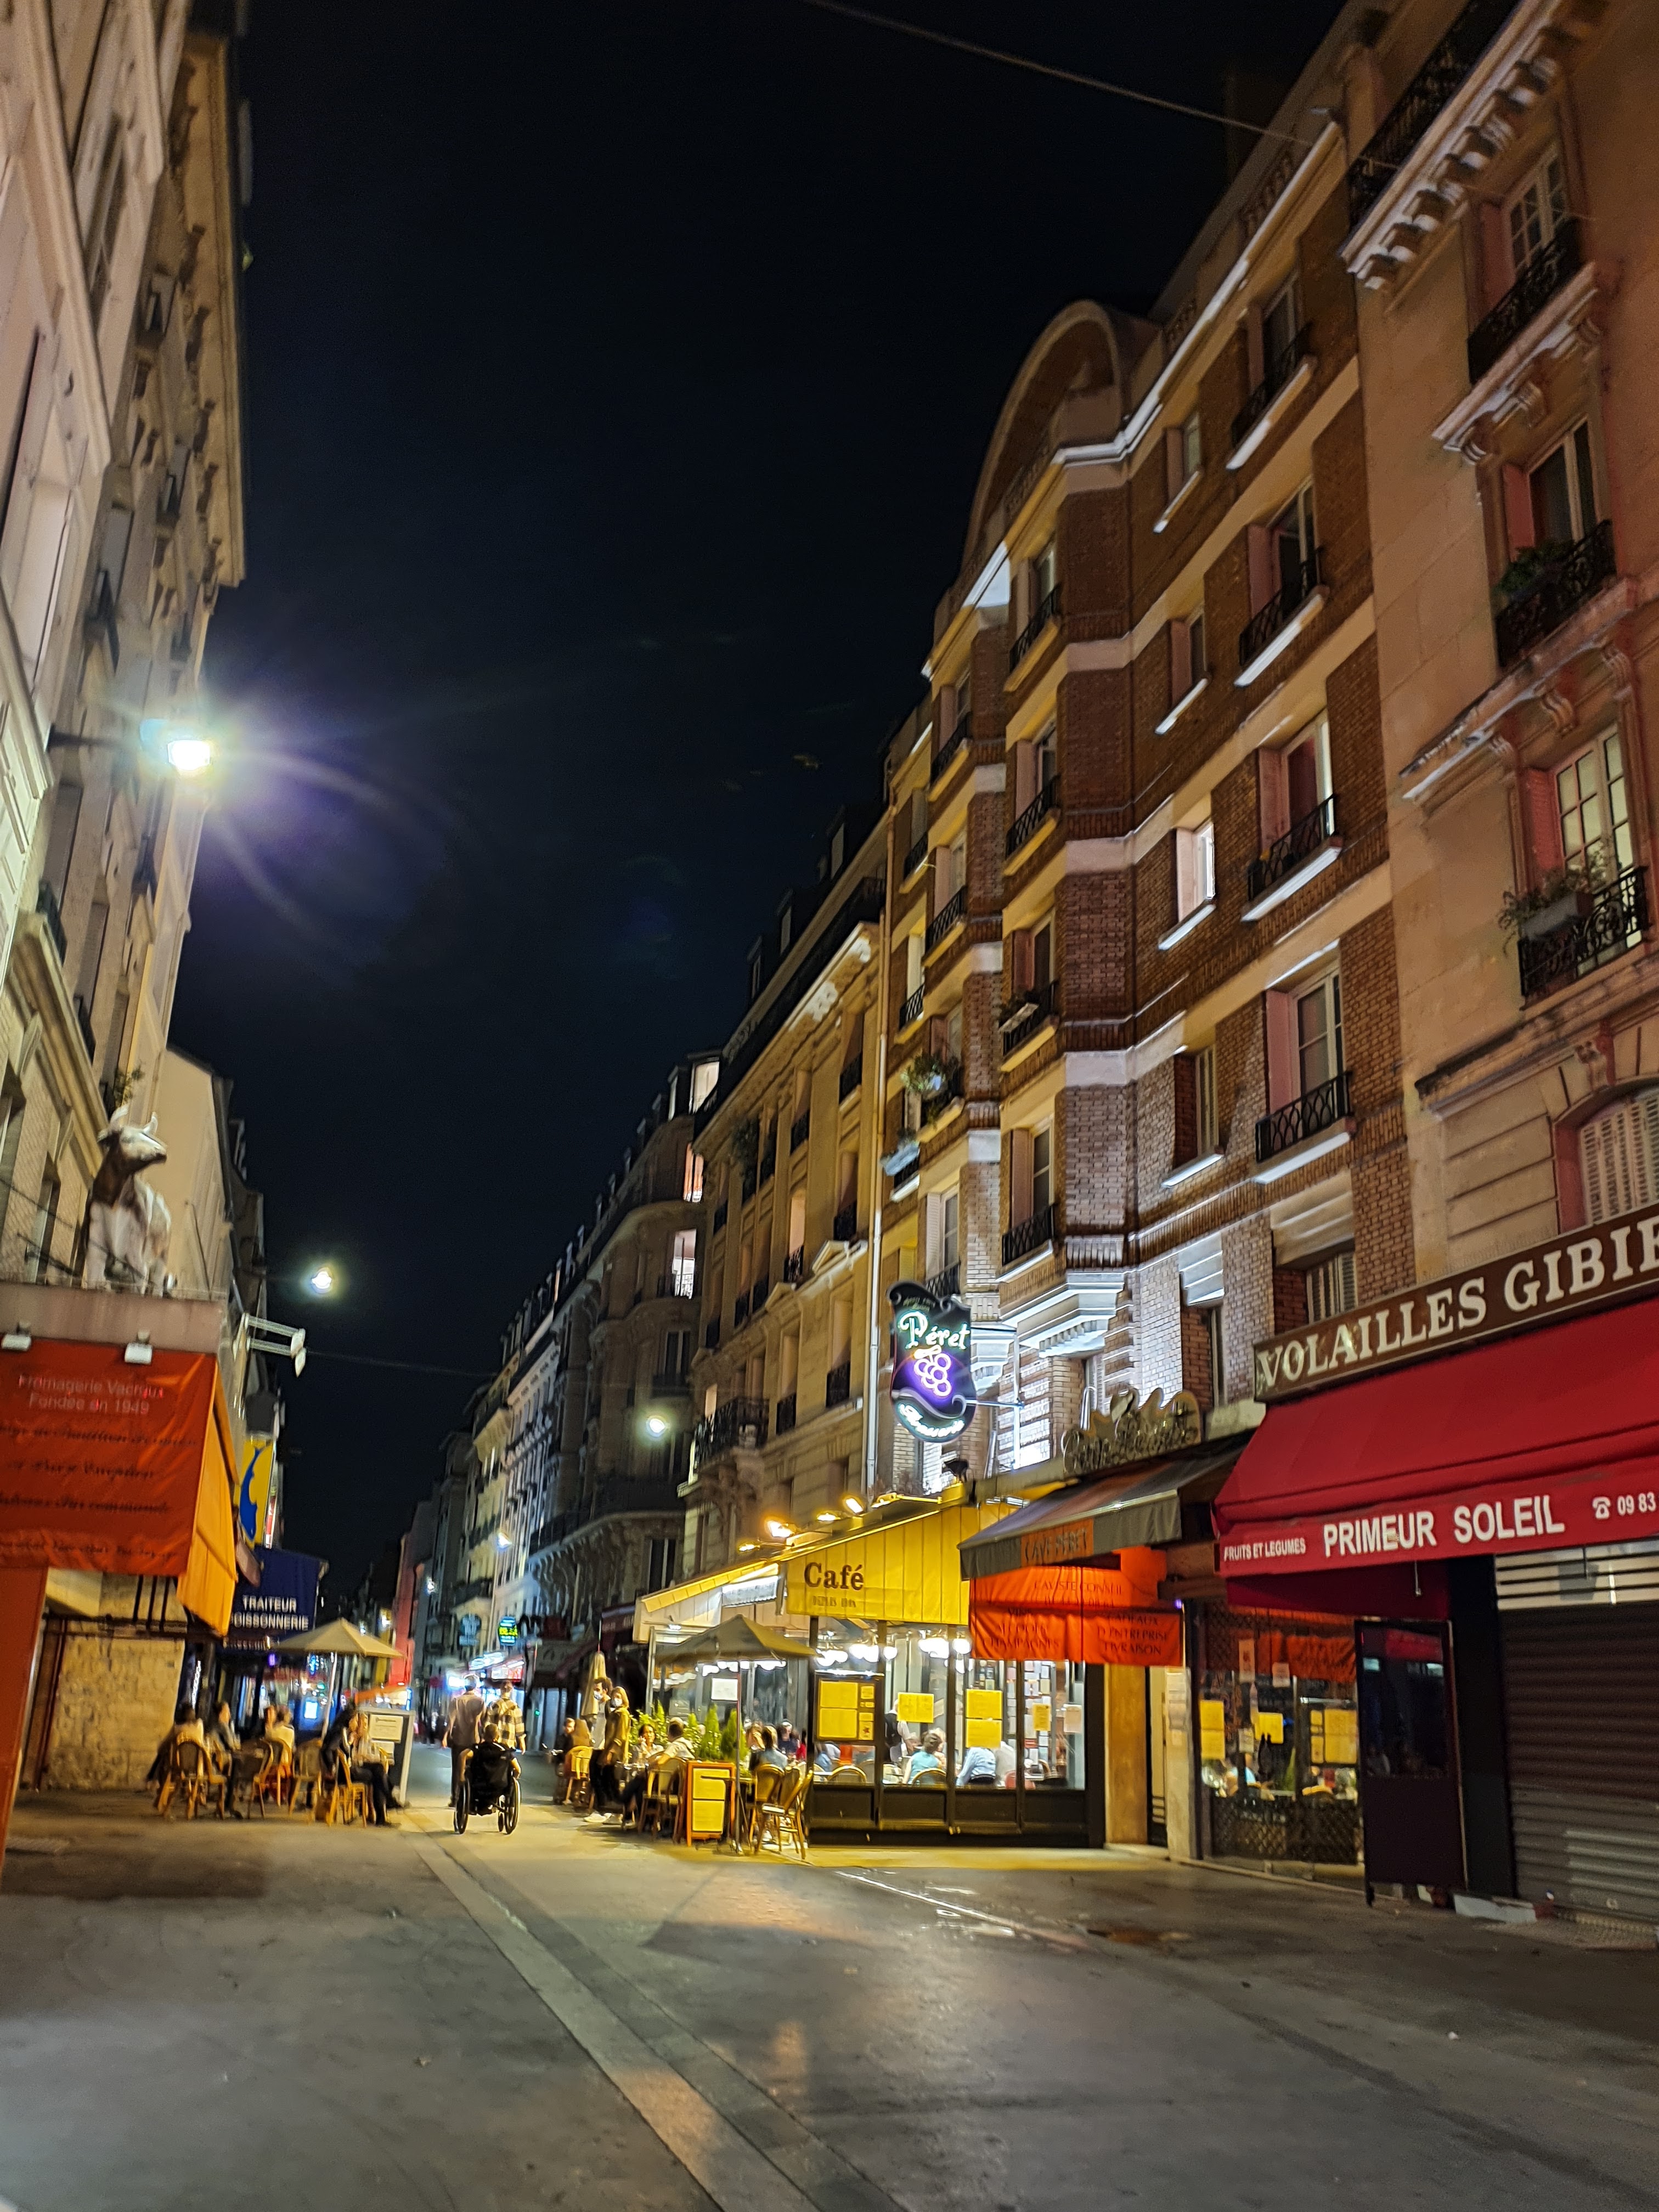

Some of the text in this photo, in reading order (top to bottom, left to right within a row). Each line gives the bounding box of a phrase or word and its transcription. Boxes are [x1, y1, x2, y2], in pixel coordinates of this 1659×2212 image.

[899, 1311, 970, 1350] Péret
[1259, 1277, 1486, 1387] VOLAILLES
[1324, 1491, 1656, 1557] PRIMEUR SOLEIL 09 83
[1224, 1537, 1306, 1562] FRUITS ET LEGUMES
[804, 1562, 864, 1590] Café
[242, 1594, 297, 1613] TRAITEUR
[232, 1611, 309, 1631] OISSONNERIE
